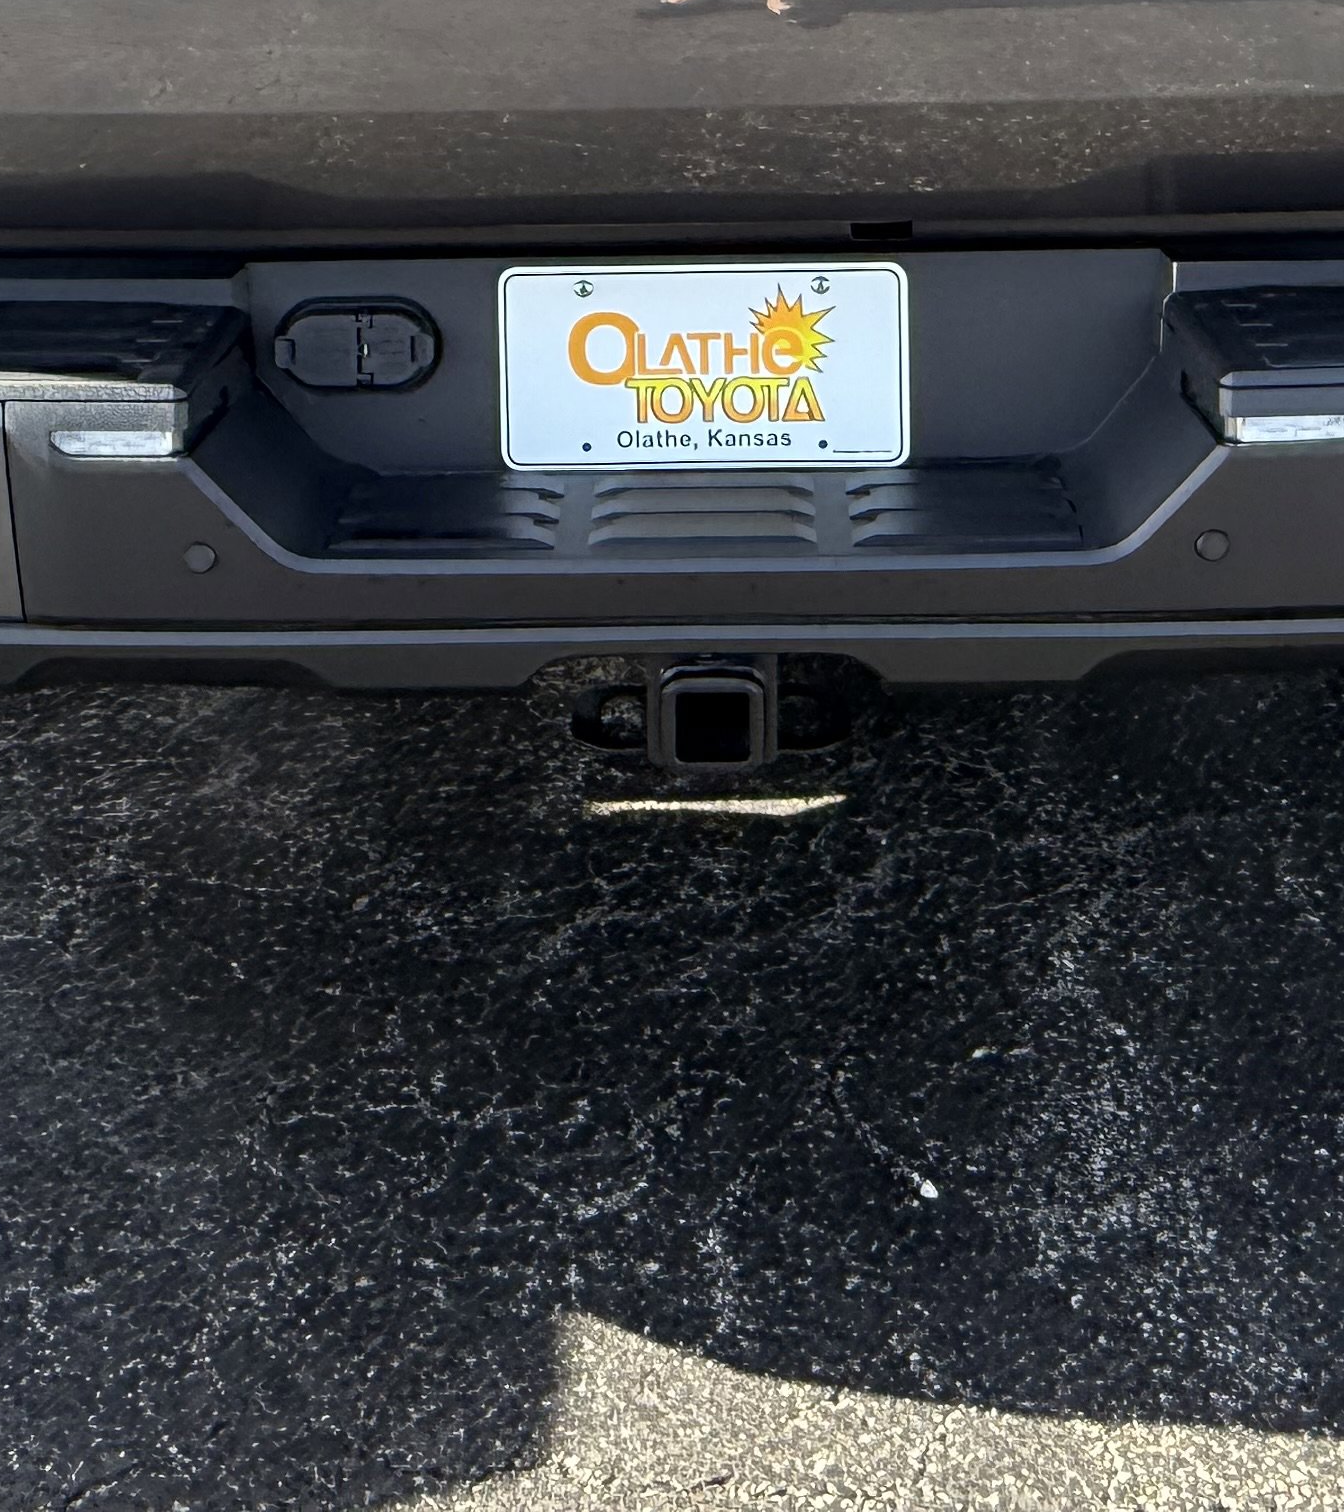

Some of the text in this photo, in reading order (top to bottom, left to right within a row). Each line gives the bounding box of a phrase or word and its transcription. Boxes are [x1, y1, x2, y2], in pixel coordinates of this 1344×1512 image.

[624, 376, 826, 424] TOYOTA
[617, 428, 792, 452] Olathe, Kansas
